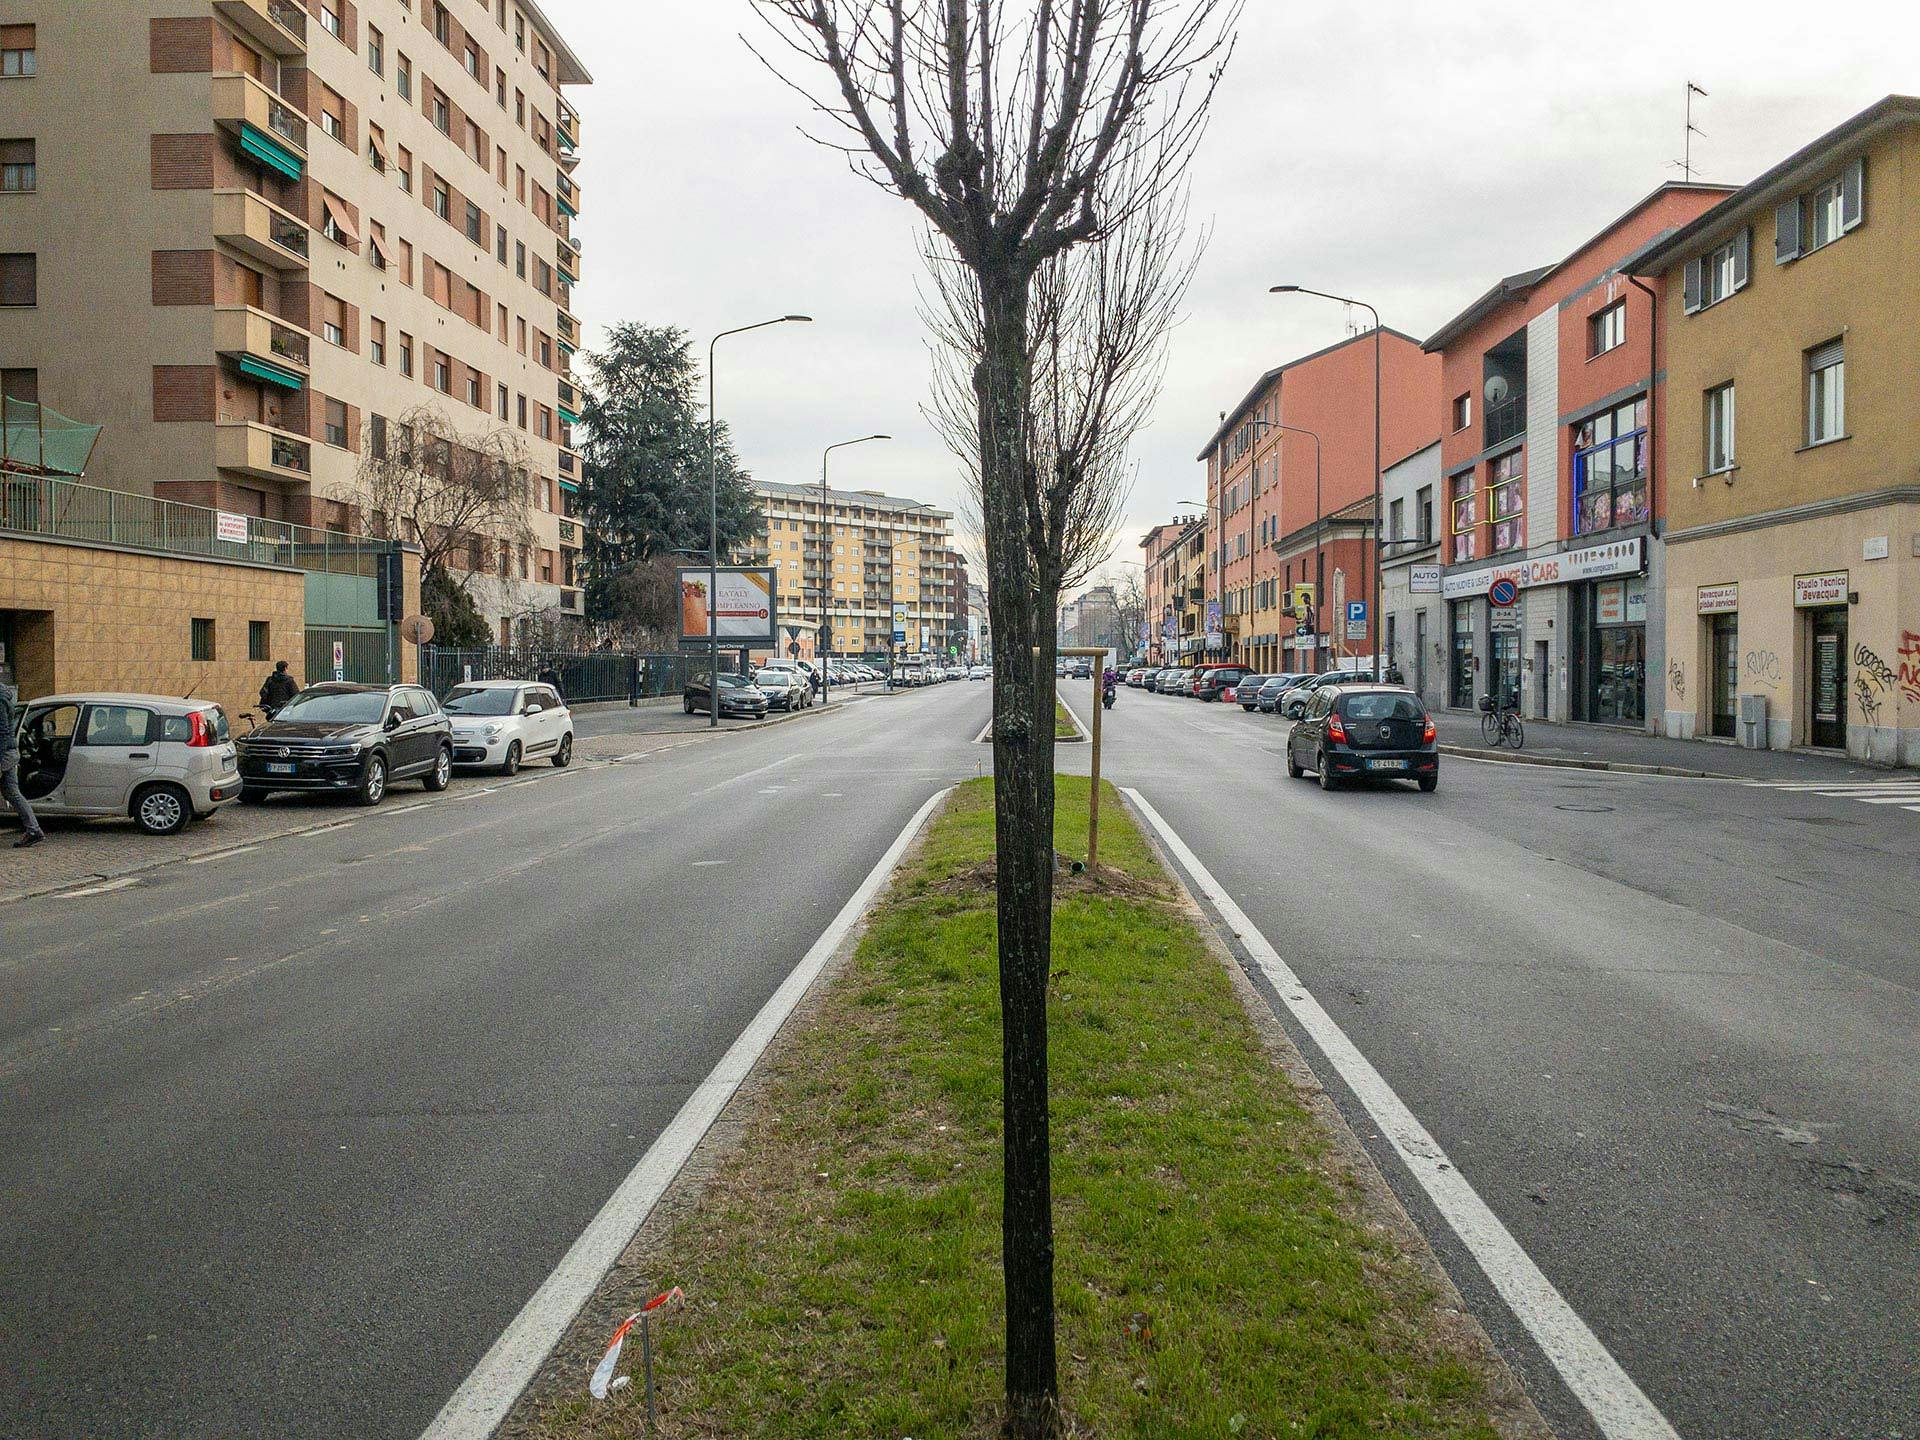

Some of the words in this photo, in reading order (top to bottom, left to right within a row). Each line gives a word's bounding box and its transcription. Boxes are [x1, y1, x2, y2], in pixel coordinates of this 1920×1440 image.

[1412, 572, 1439, 580] AUTO
[1531, 562, 1559, 582] CARS
[1797, 578, 1818, 589] Studio
[1820, 576, 1846, 588] Tecnico
[719, 590, 749, 598] EATALY
[1700, 590, 1724, 599] Bevacqua
[1802, 588, 1840, 601] Bevacqua
[1350, 603, 1364, 619] P
